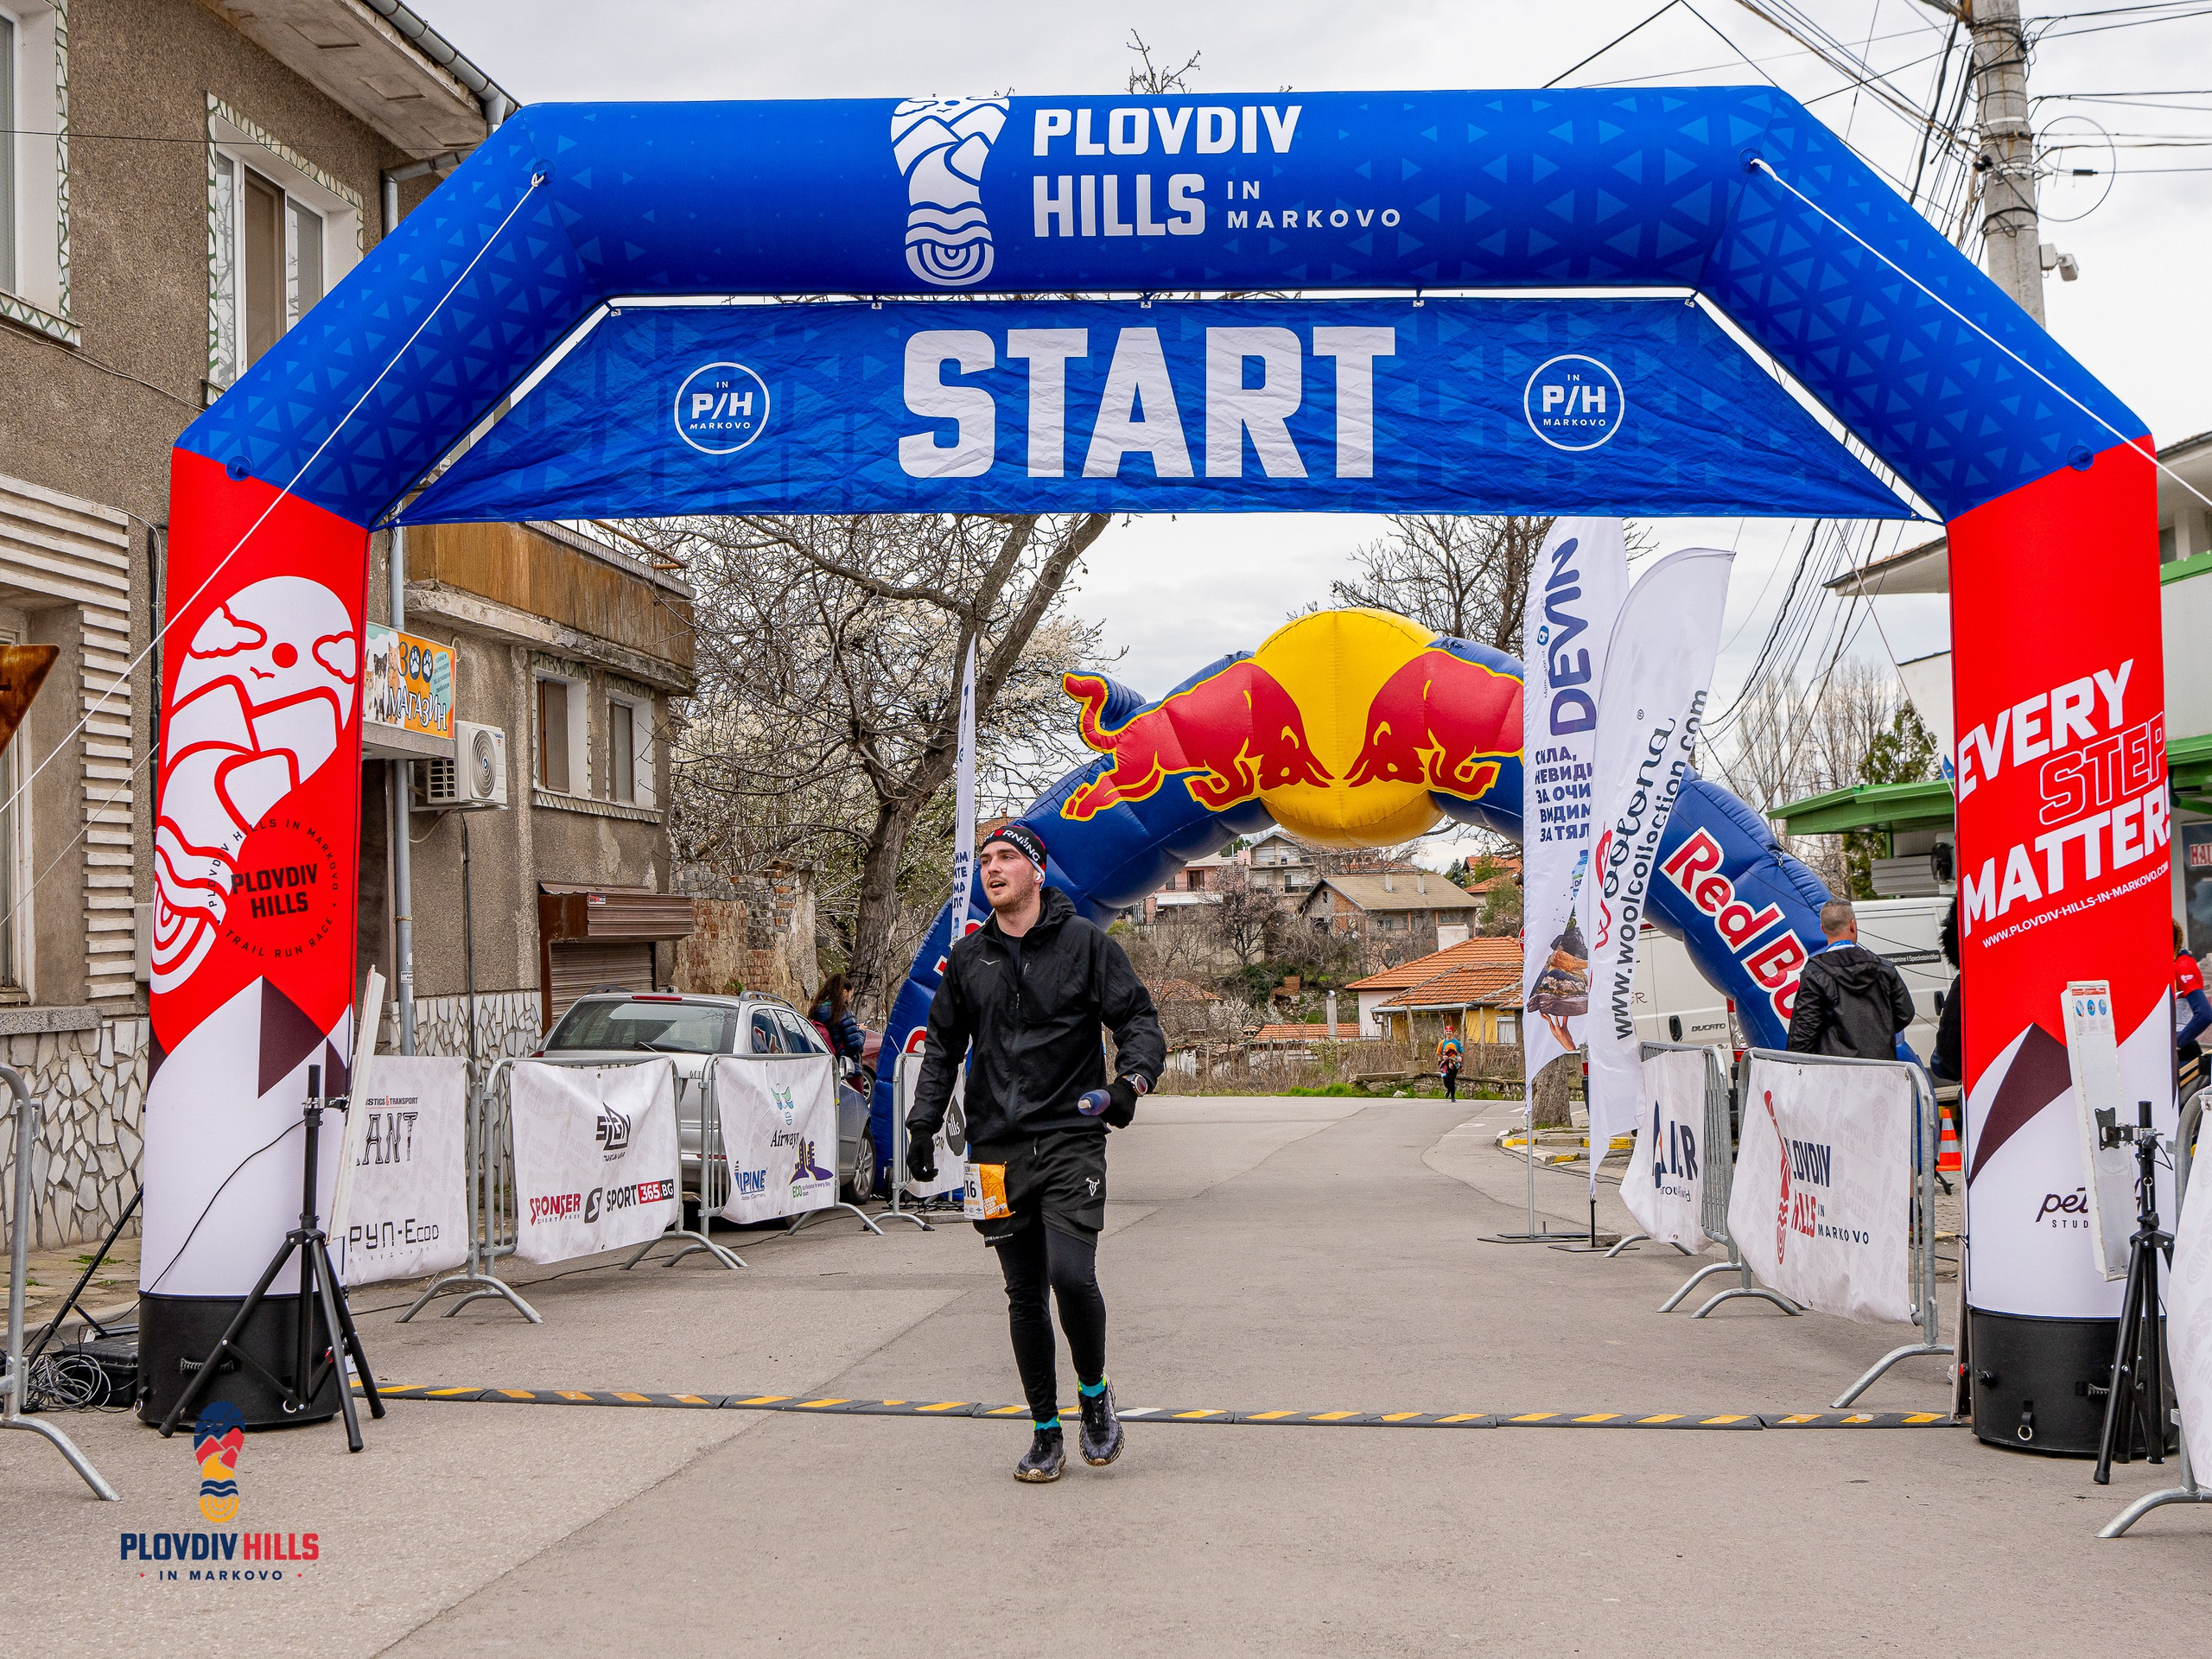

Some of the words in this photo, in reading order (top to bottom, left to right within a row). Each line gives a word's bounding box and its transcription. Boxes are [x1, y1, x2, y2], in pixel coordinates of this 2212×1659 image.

[1033, 105, 1302, 156] PLOVDIV
[1033, 173, 1205, 237] HILLS
[1227, 181, 1261, 200] IN
[1227, 208, 1402, 229] MARKOVO
[692, 391, 753, 420] P/H
[898, 326, 1396, 479] START
[1542, 385, 1605, 416] P/H
[690, 422, 751, 430] MARKOVO
[1543, 418, 1606, 427] MARKOVO
[1545, 537, 1597, 736] DEVIN
[388, 685, 448, 732] МАГАЗИН
[1959, 658, 2133, 804] EVERY
[1535, 746, 1577, 766] СИЛА,
[2039, 710, 2164, 826] STEP
[208, 842, 230, 907] PLOVDIV
[233, 819, 277, 841] HILLS
[286, 820, 301, 830] IN
[306, 828, 339, 890] MARKOVO
[231, 863, 317, 894] PLOVDIV
[1612, 690, 1707, 1040] www.woolcollectioncom
[251, 892, 308, 918] HILLS
[1662, 830, 1782, 950] Red
[226, 929, 264, 957] TRAIL
[275, 946, 303, 958] RUN
[309, 917, 334, 947] RACE
[1691, 1023, 1726, 1033] DUCATO
[356, 1112, 418, 1166] ANT
[529, 1193, 582, 1226] SPONSER
[1818, 1204, 1825, 1217] IN
[2035, 1187, 2088, 1223] pet
[1818, 1224, 1869, 1244] MARKOVO
[2051, 1219, 2089, 1229] STUD
